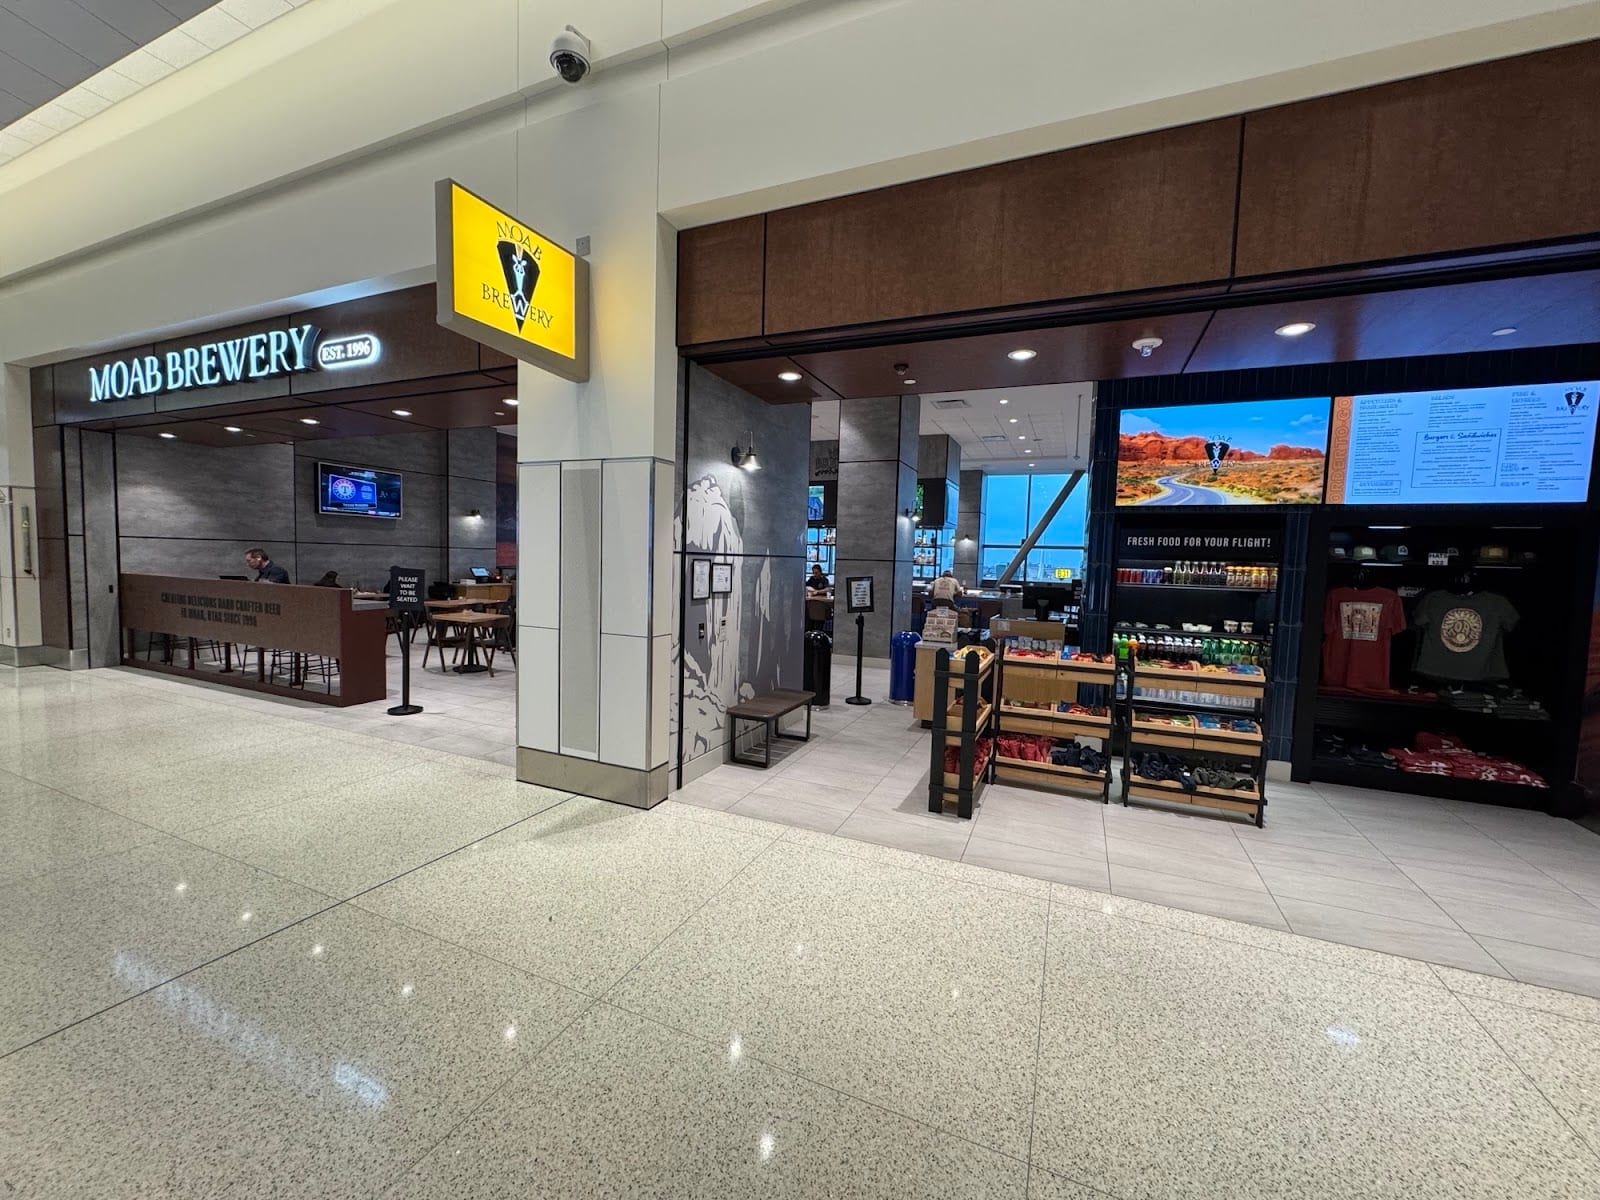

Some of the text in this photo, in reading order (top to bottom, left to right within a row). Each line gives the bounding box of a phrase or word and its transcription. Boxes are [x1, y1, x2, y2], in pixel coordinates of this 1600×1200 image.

[497, 221, 542, 260] MOAB
[481, 282, 553, 329] BREWERY
[89, 324, 312, 402] MOAB BREWERY
[321, 340, 370, 361] EST. 1996
[1127, 536, 1271, 548] FRESH FOOD FOR YOUR FLIGHT!
